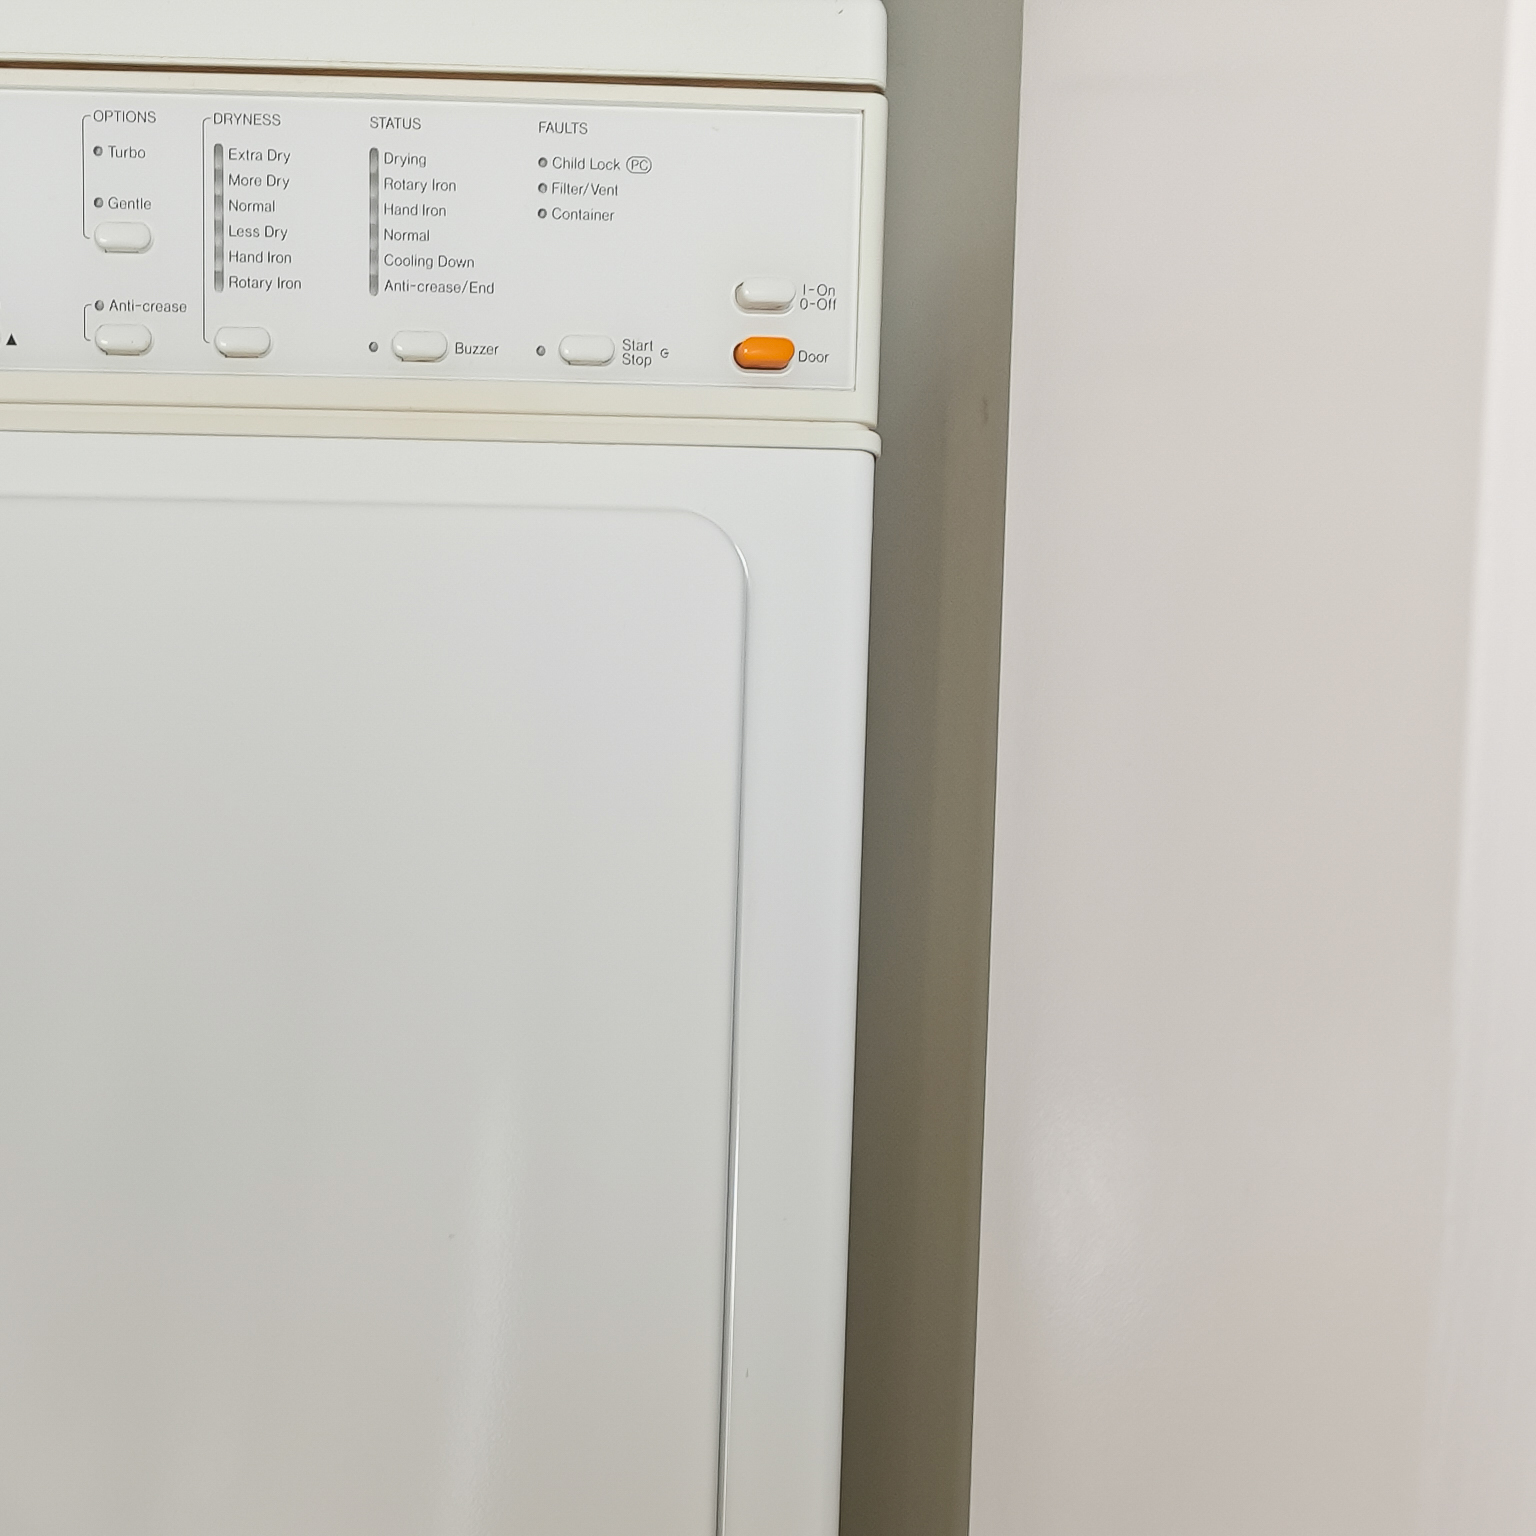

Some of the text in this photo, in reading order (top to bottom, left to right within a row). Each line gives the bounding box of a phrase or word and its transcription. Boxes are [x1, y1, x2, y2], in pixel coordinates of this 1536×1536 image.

[93, 109, 157, 124] OPTIONS
[213, 112, 281, 127] DRYNESS
[369, 116, 422, 130] STATUS
[538, 120, 588, 135] FAULTS
[107, 145, 146, 159] Turbo
[228, 147, 291, 165] Extra Dry
[383, 151, 427, 168] Drying
[552, 156, 586, 170] Child
[589, 157, 621, 171] Lock
[228, 172, 290, 191] More Dry
[383, 176, 457, 194] Rotary Iron
[551, 181, 618, 197] Filter/Vent
[107, 196, 152, 210] Gentle
[228, 198, 276, 213] Normal
[383, 202, 447, 217] Hand Iron
[551, 206, 615, 222] Container
[228, 224, 288, 242] Less Dry
[383, 227, 430, 242] Normal
[228, 249, 292, 264] Hand Iron
[383, 253, 475, 270] Cooling Down
[228, 275, 302, 293] Rotary Iron
[384, 279, 495, 295] Anti-crease/End
[108, 298, 187, 313] Anti-crease
[454, 341, 500, 356] Buzzer
[622, 338, 654, 352] Start
[622, 353, 653, 369] Stop
[798, 349, 830, 364] Door
